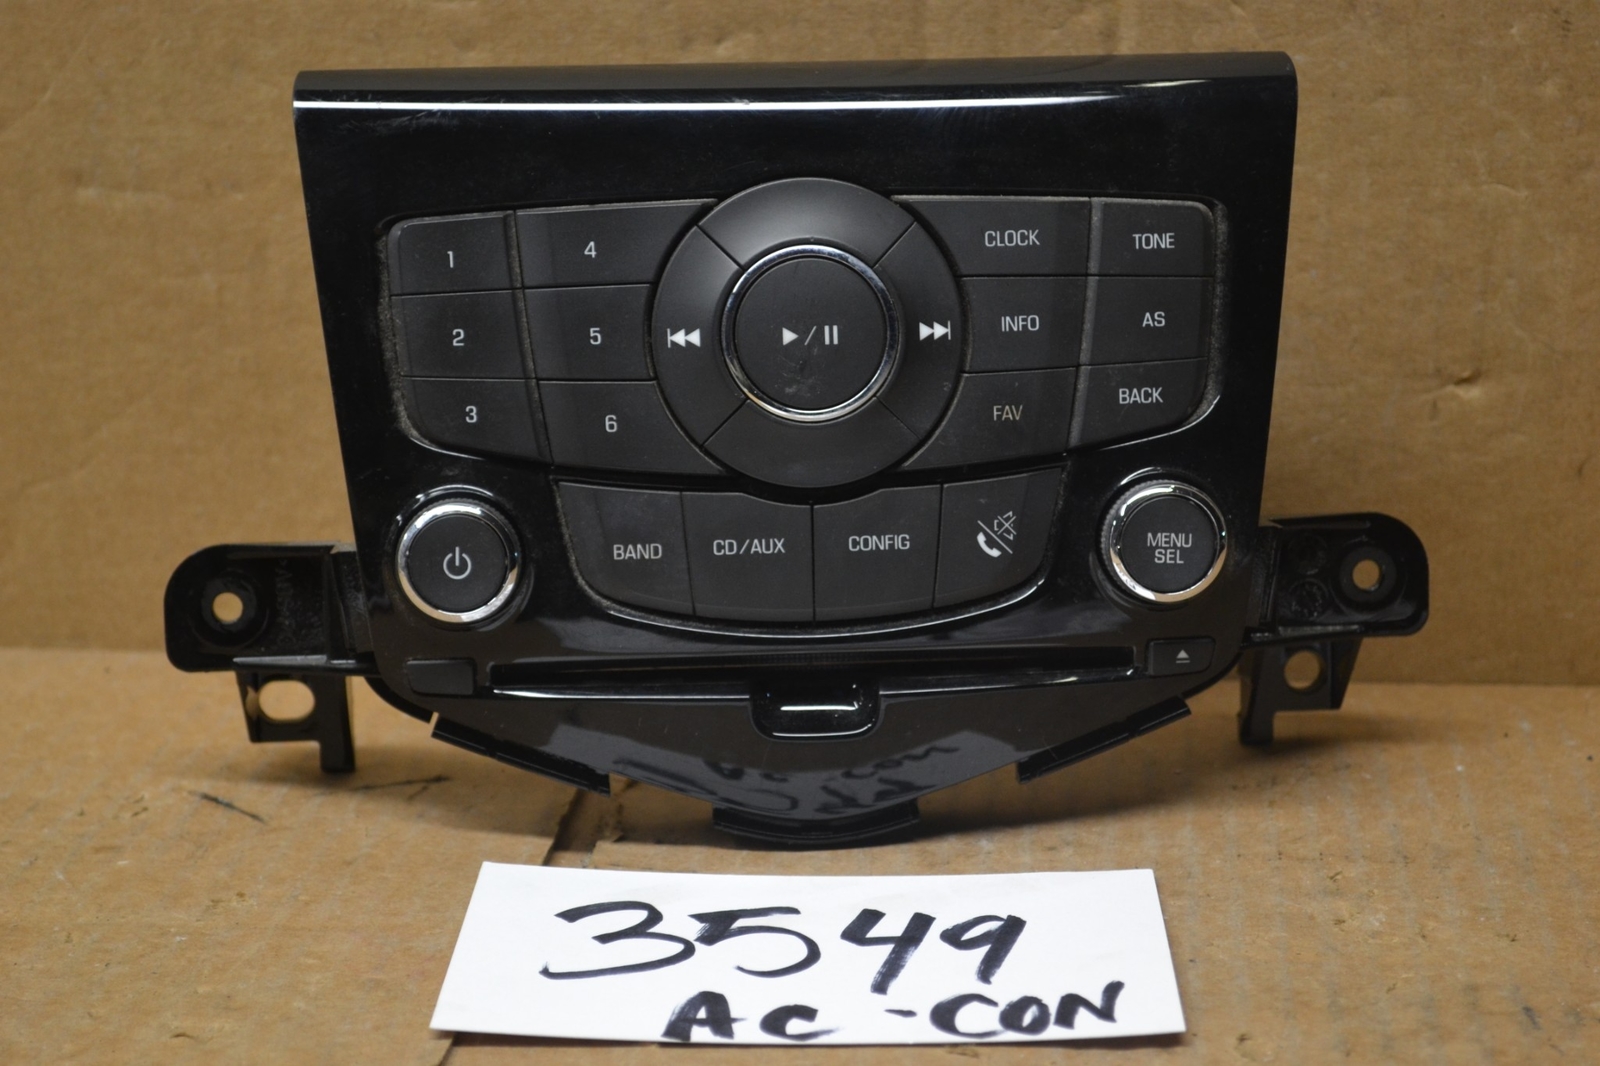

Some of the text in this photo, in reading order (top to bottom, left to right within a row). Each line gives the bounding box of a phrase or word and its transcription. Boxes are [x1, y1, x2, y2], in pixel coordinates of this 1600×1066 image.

[983, 229, 1041, 248] CLOCK
[1131, 232, 1177, 250] TONE
[582, 240, 598, 259] 4
[445, 250, 456, 269] 1
[1000, 314, 1041, 333] INFO
[1141, 311, 1167, 328] AS
[451, 328, 466, 347] 2
[588, 327, 603, 346] 5
[1117, 386, 1165, 405] BACK
[464, 405, 479, 424] 3
[992, 404, 1024, 422] FAV
[603, 414, 619, 434] 6
[712, 537, 787, 556] CD/AUX
[847, 533, 912, 552] CONFIG
[1146, 531, 1193, 549] MENU
[612, 543, 664, 561] BAND
[1153, 547, 1185, 565] SEL
[539, 900, 1028, 996] 3549
[663, 991, 836, 1041] AC
